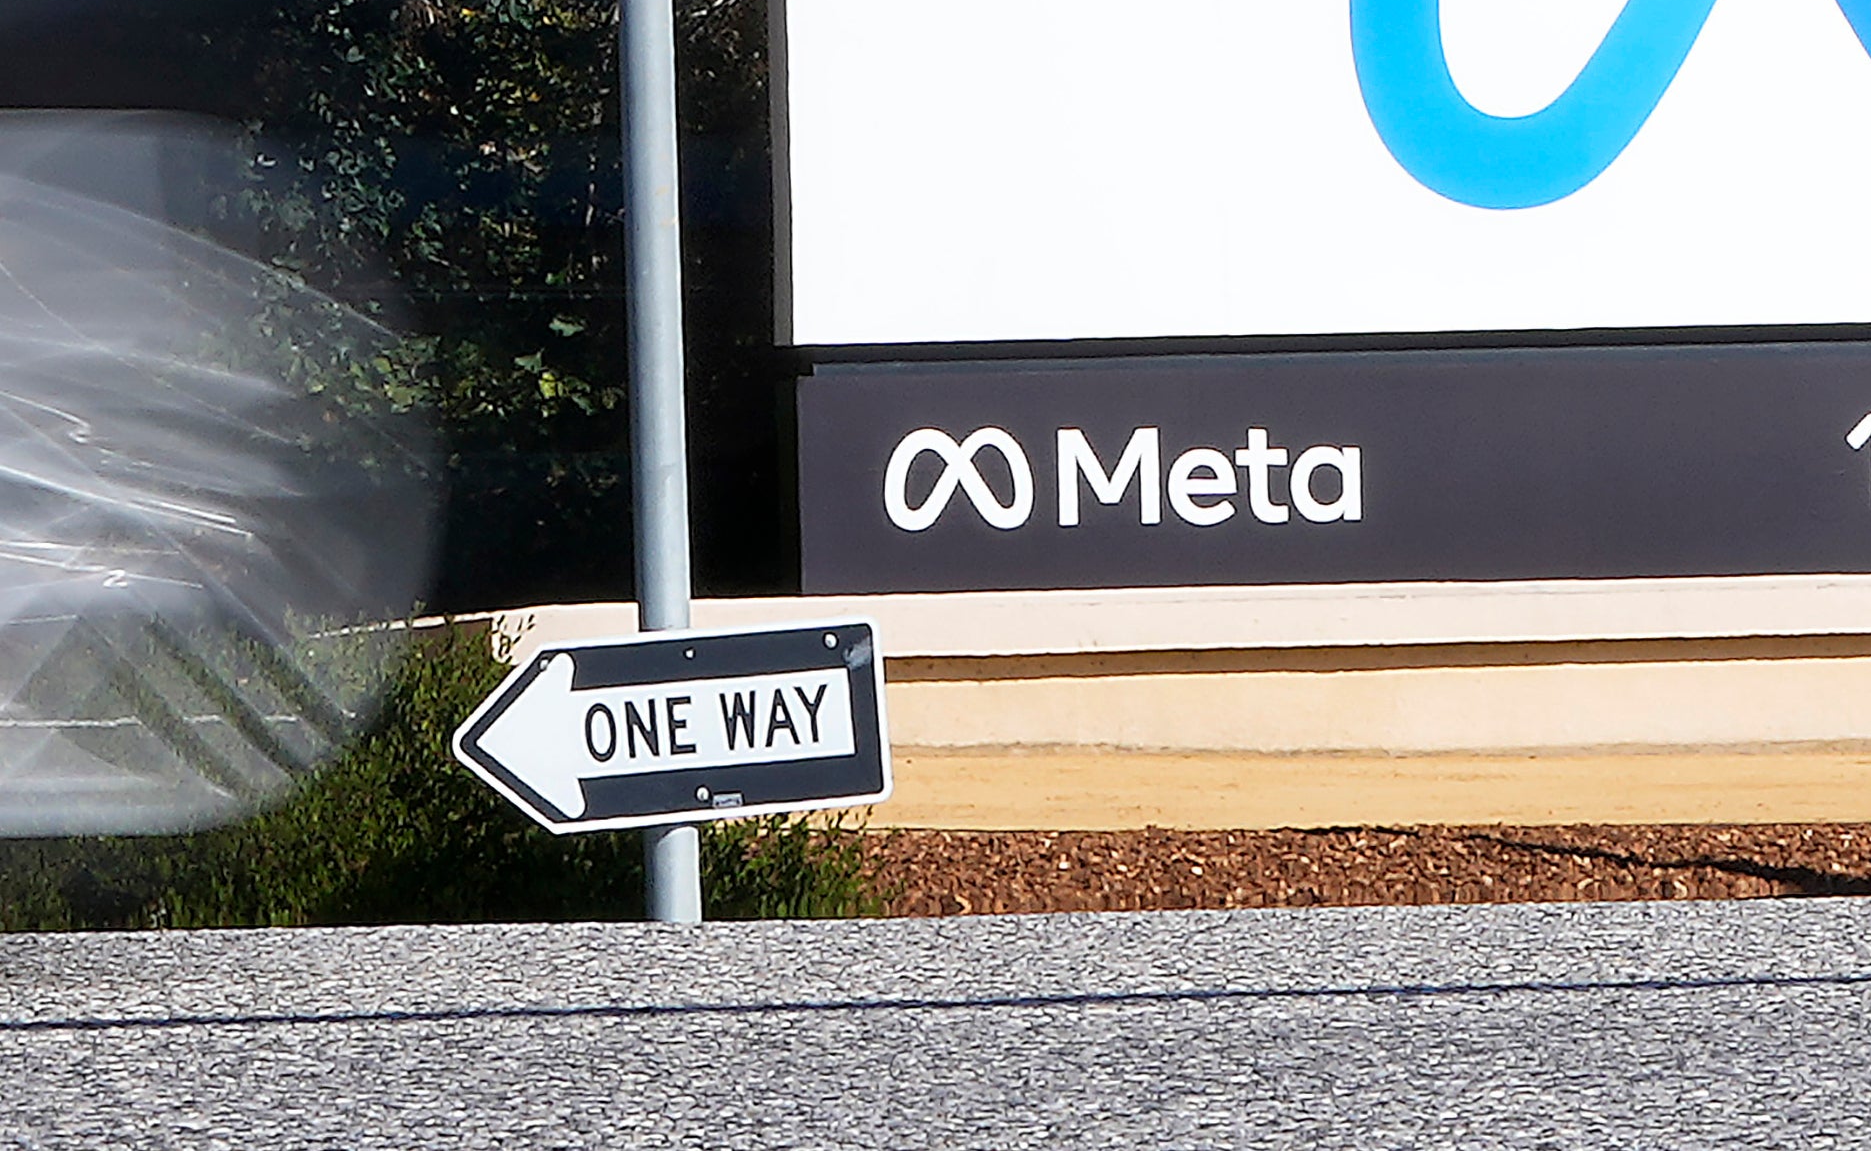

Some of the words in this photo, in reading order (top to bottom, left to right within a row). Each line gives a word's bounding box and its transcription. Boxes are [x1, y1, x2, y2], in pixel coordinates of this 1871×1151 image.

[1057, 427, 1363, 526] Meta
[584, 695, 697, 763] ONE
[719, 683, 829, 751] WAY
